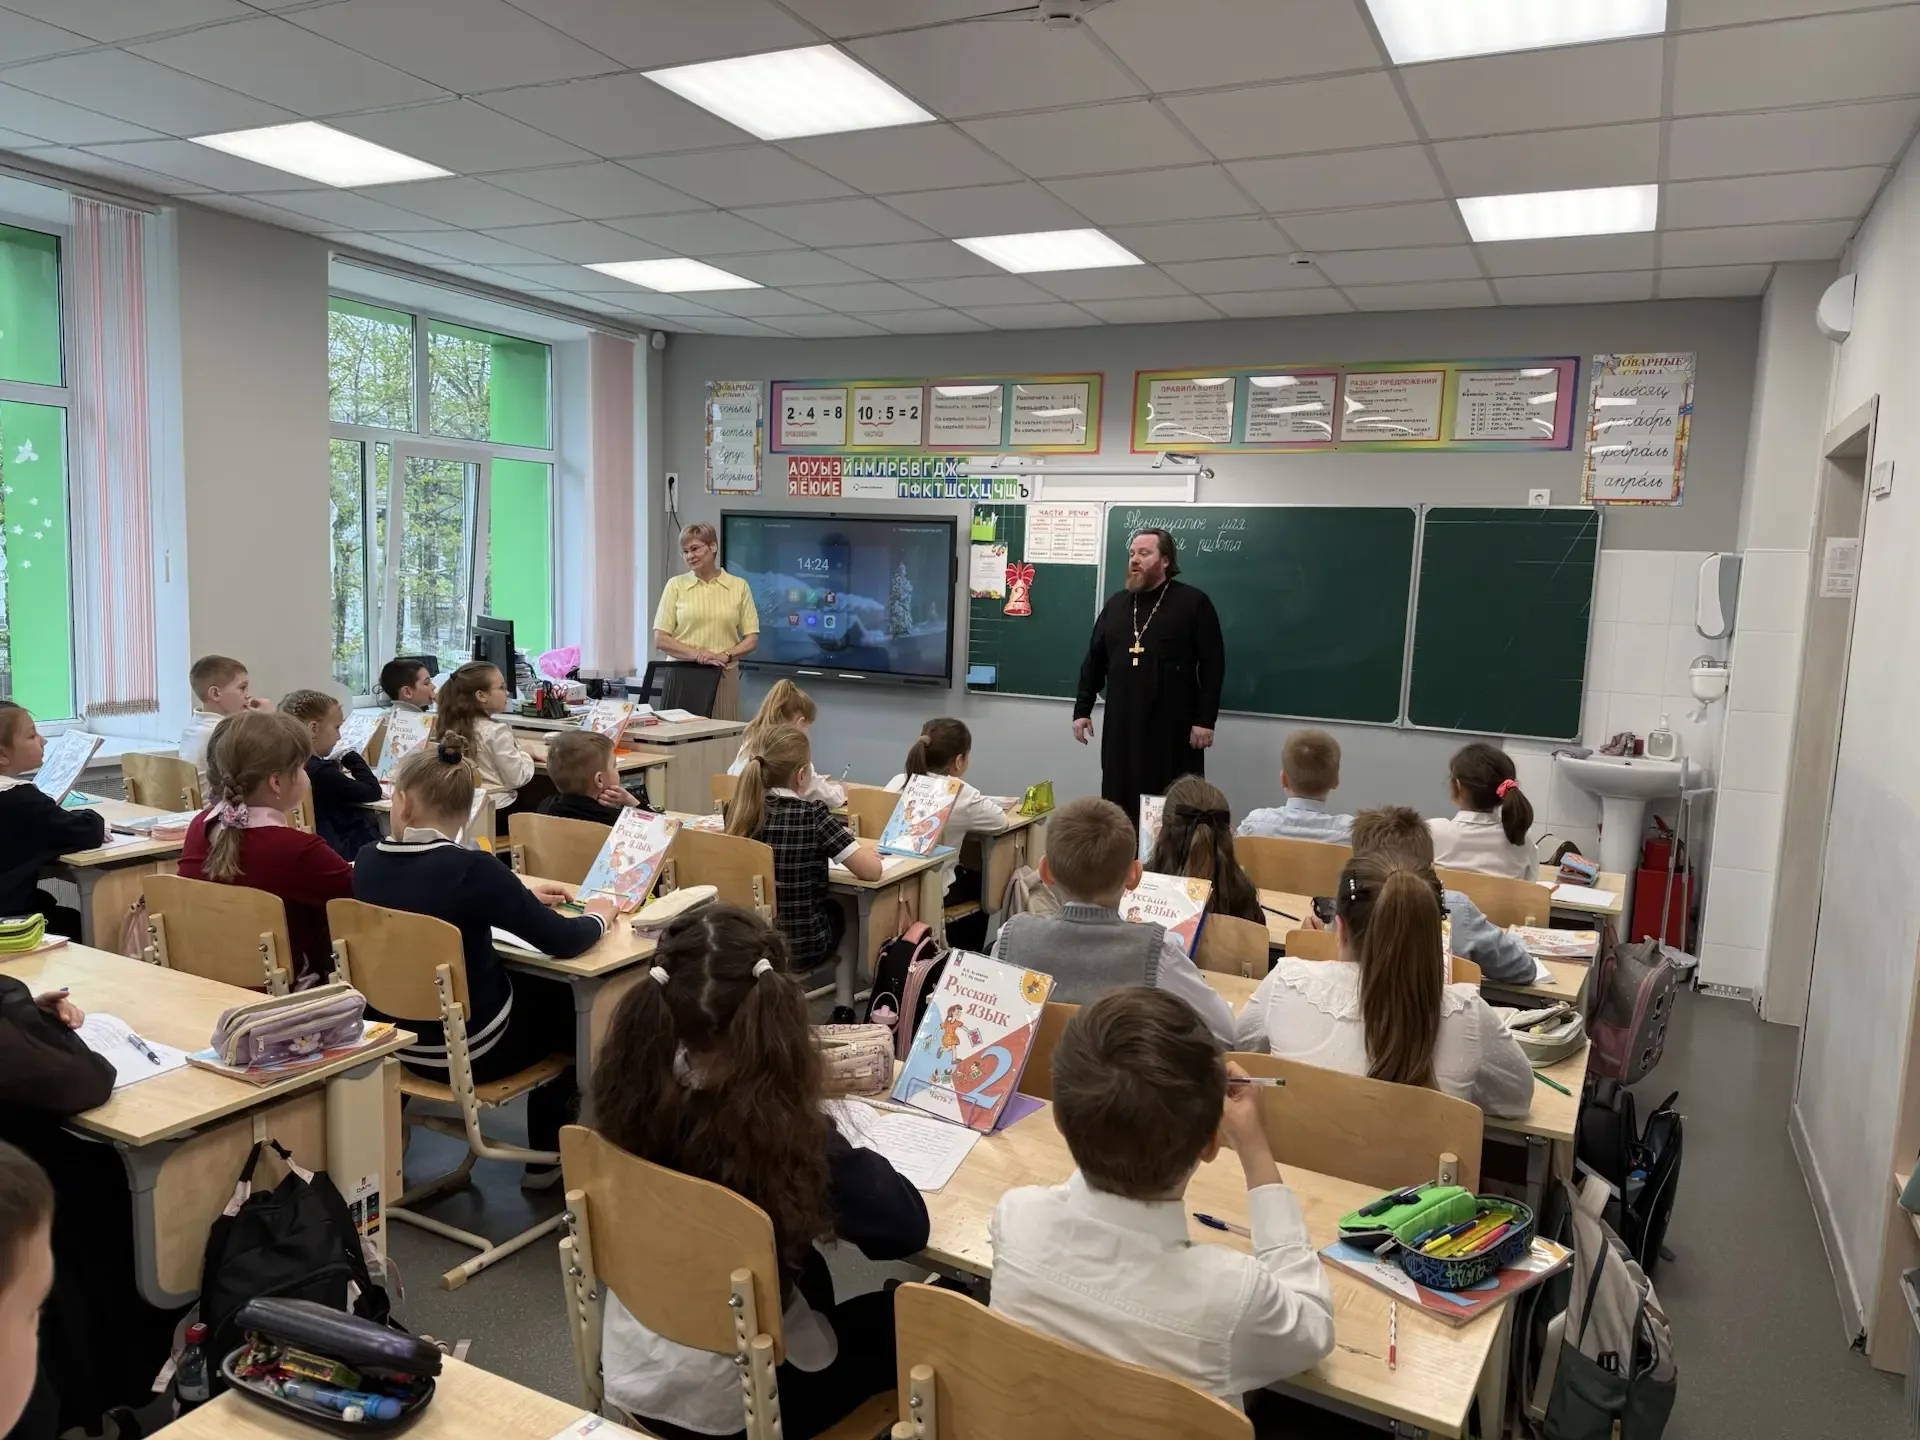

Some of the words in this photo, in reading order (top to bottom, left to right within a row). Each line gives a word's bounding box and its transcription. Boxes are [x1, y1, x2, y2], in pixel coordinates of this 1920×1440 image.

[1161, 385, 1197, 393] ПРАВИЛА
[1380, 378, 1437, 386] ПРЕДЛОЖЕНИЯ
[787, 407, 795, 420] 2
[806, 407, 815, 420] 4
[834, 406, 843, 420] 8
[858, 406, 873, 420] 10
[886, 406, 895, 420] 5
[910, 406, 919, 420] 2
[1196, 531, 1242, 557] работа
[797, 557, 829, 571] 14:24
[1014, 586, 1025, 602] 2
[944, 975, 999, 1006] Русский
[962, 1045, 1013, 1110] 2
